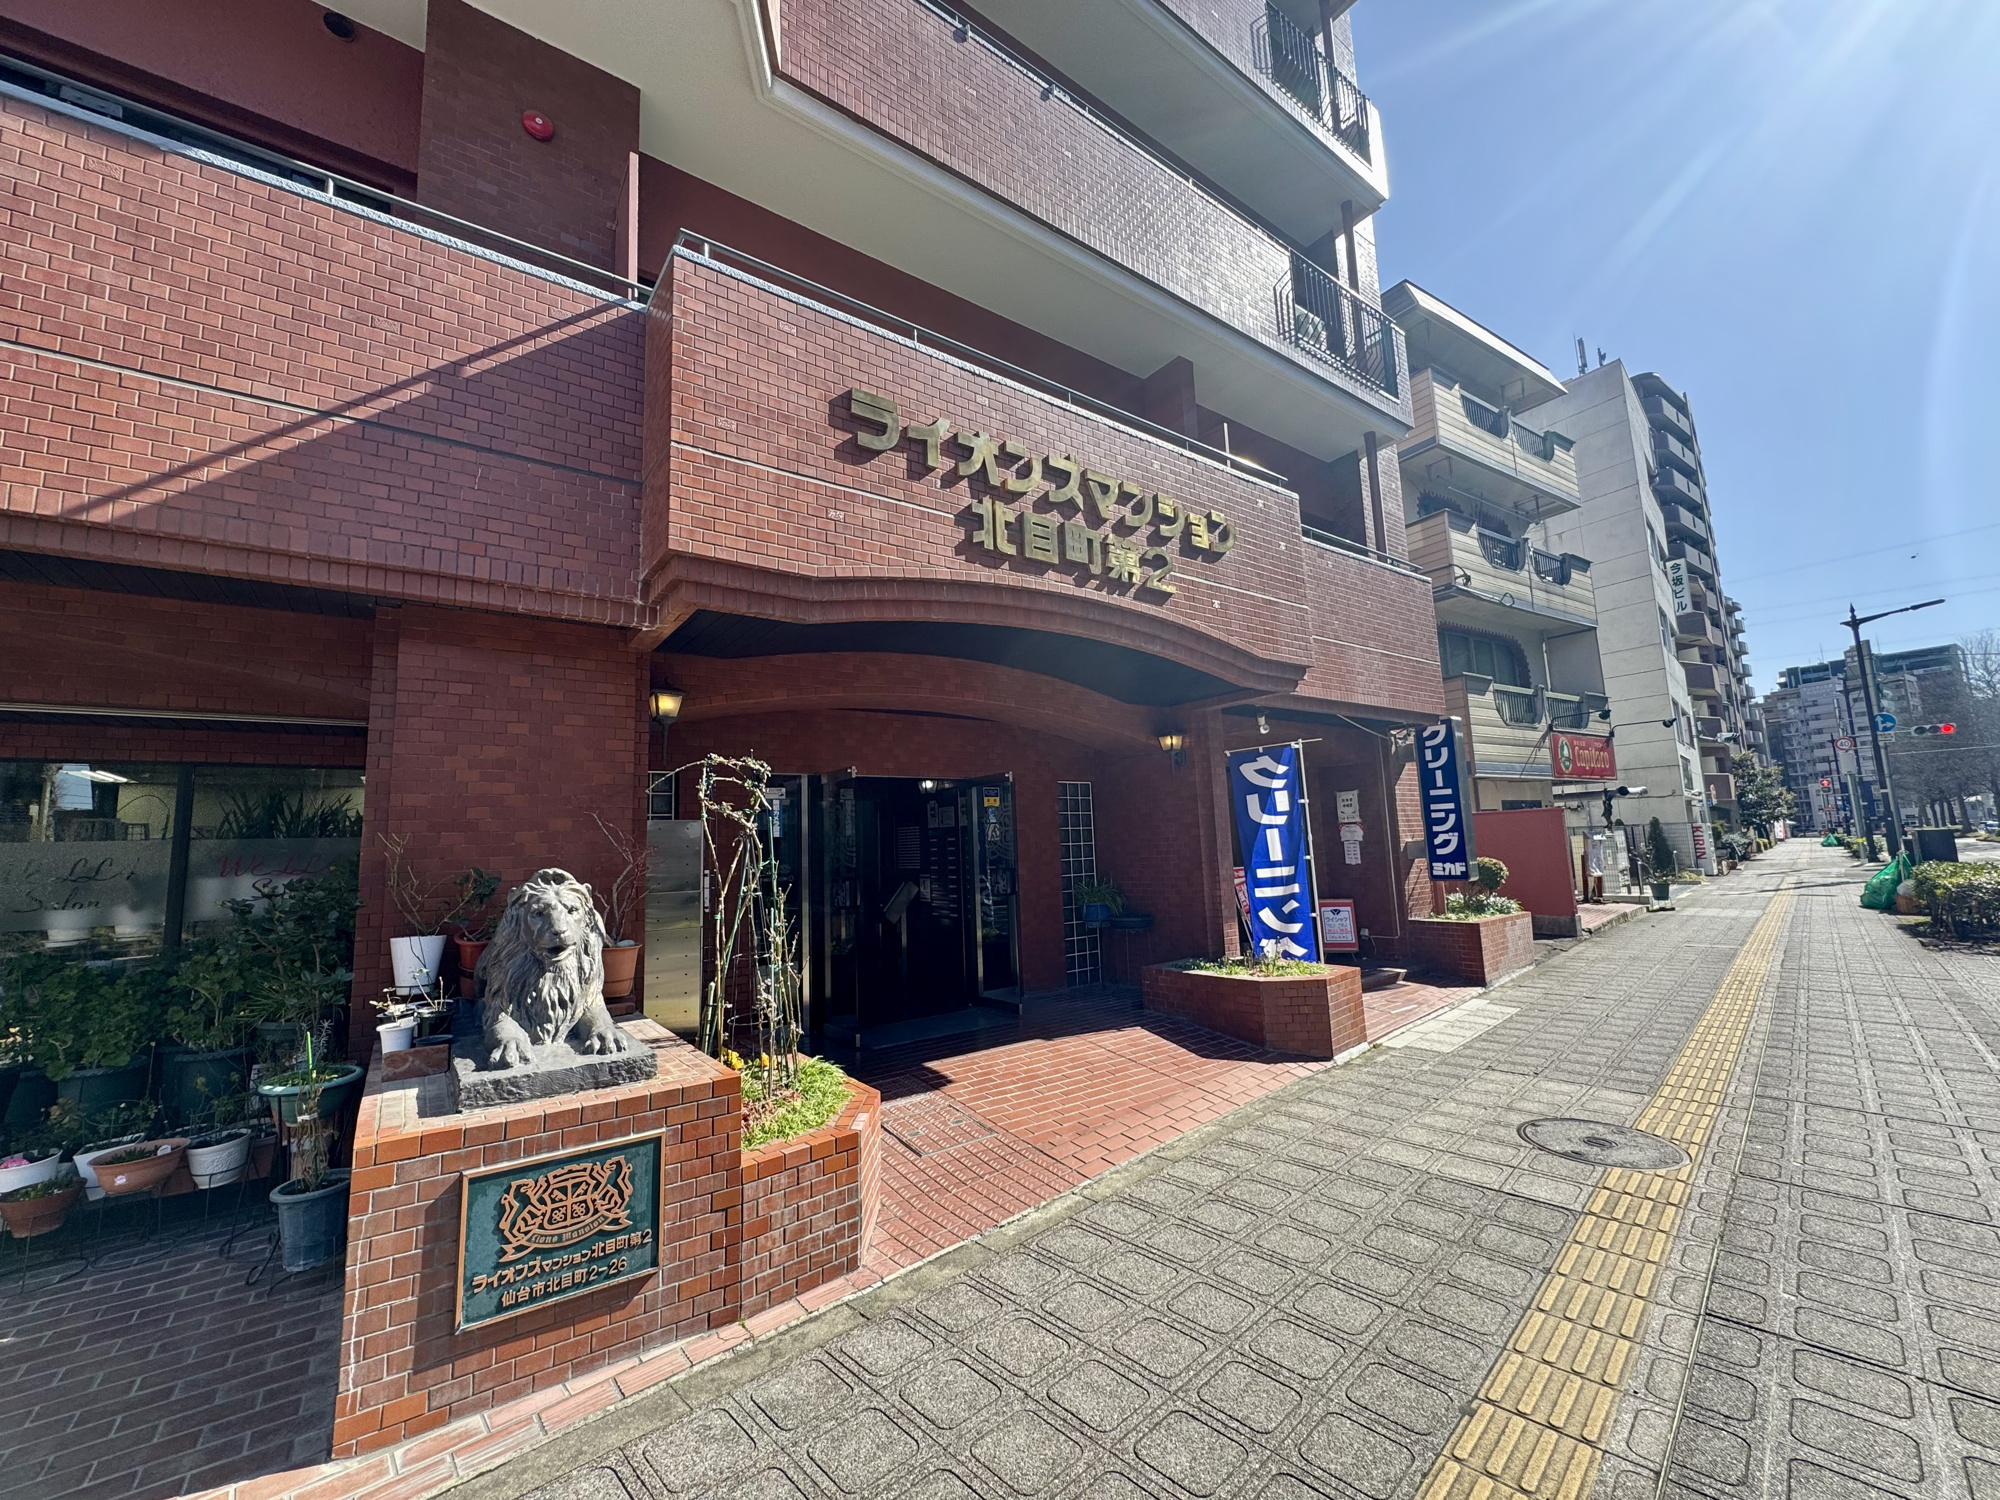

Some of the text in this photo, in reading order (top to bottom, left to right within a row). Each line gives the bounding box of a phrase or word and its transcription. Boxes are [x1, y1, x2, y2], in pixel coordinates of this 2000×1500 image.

[850, 387, 1237, 554] ライオンズマンション
[971, 495, 1176, 594] 北目町第2
[1669, 562, 1688, 612] 今坂ビル
[1839, 740, 1850, 748] 40
[1423, 724, 1459, 855] クリーニング
[1692, 825, 1708, 860] KIRIN
[1432, 862, 1467, 876] ミカド
[531, 1216, 605, 1243] Lions Mansion
[471, 1229, 653, 1294] ライオンズマンション北目町第2
[502, 1256, 628, 1307] 仙台市北目町2-26
